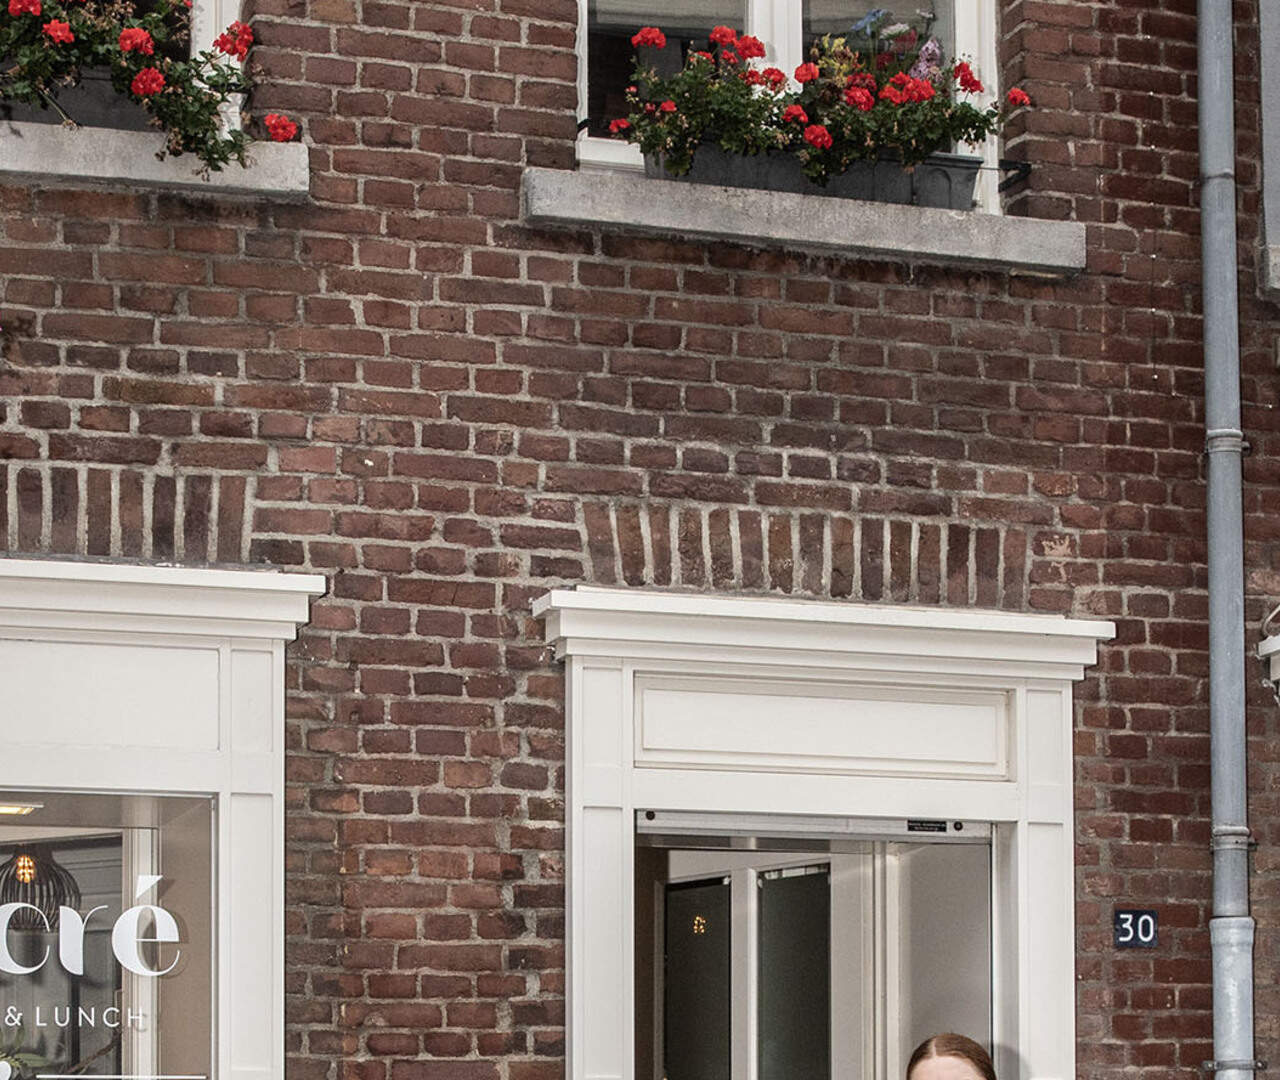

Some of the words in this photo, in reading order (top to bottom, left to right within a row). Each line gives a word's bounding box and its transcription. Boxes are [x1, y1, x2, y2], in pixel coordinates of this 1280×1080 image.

[1118, 913, 1155, 943] 30
[4, 1006, 24, 1028] &
[35, 1005, 145, 1029] LUNCH
